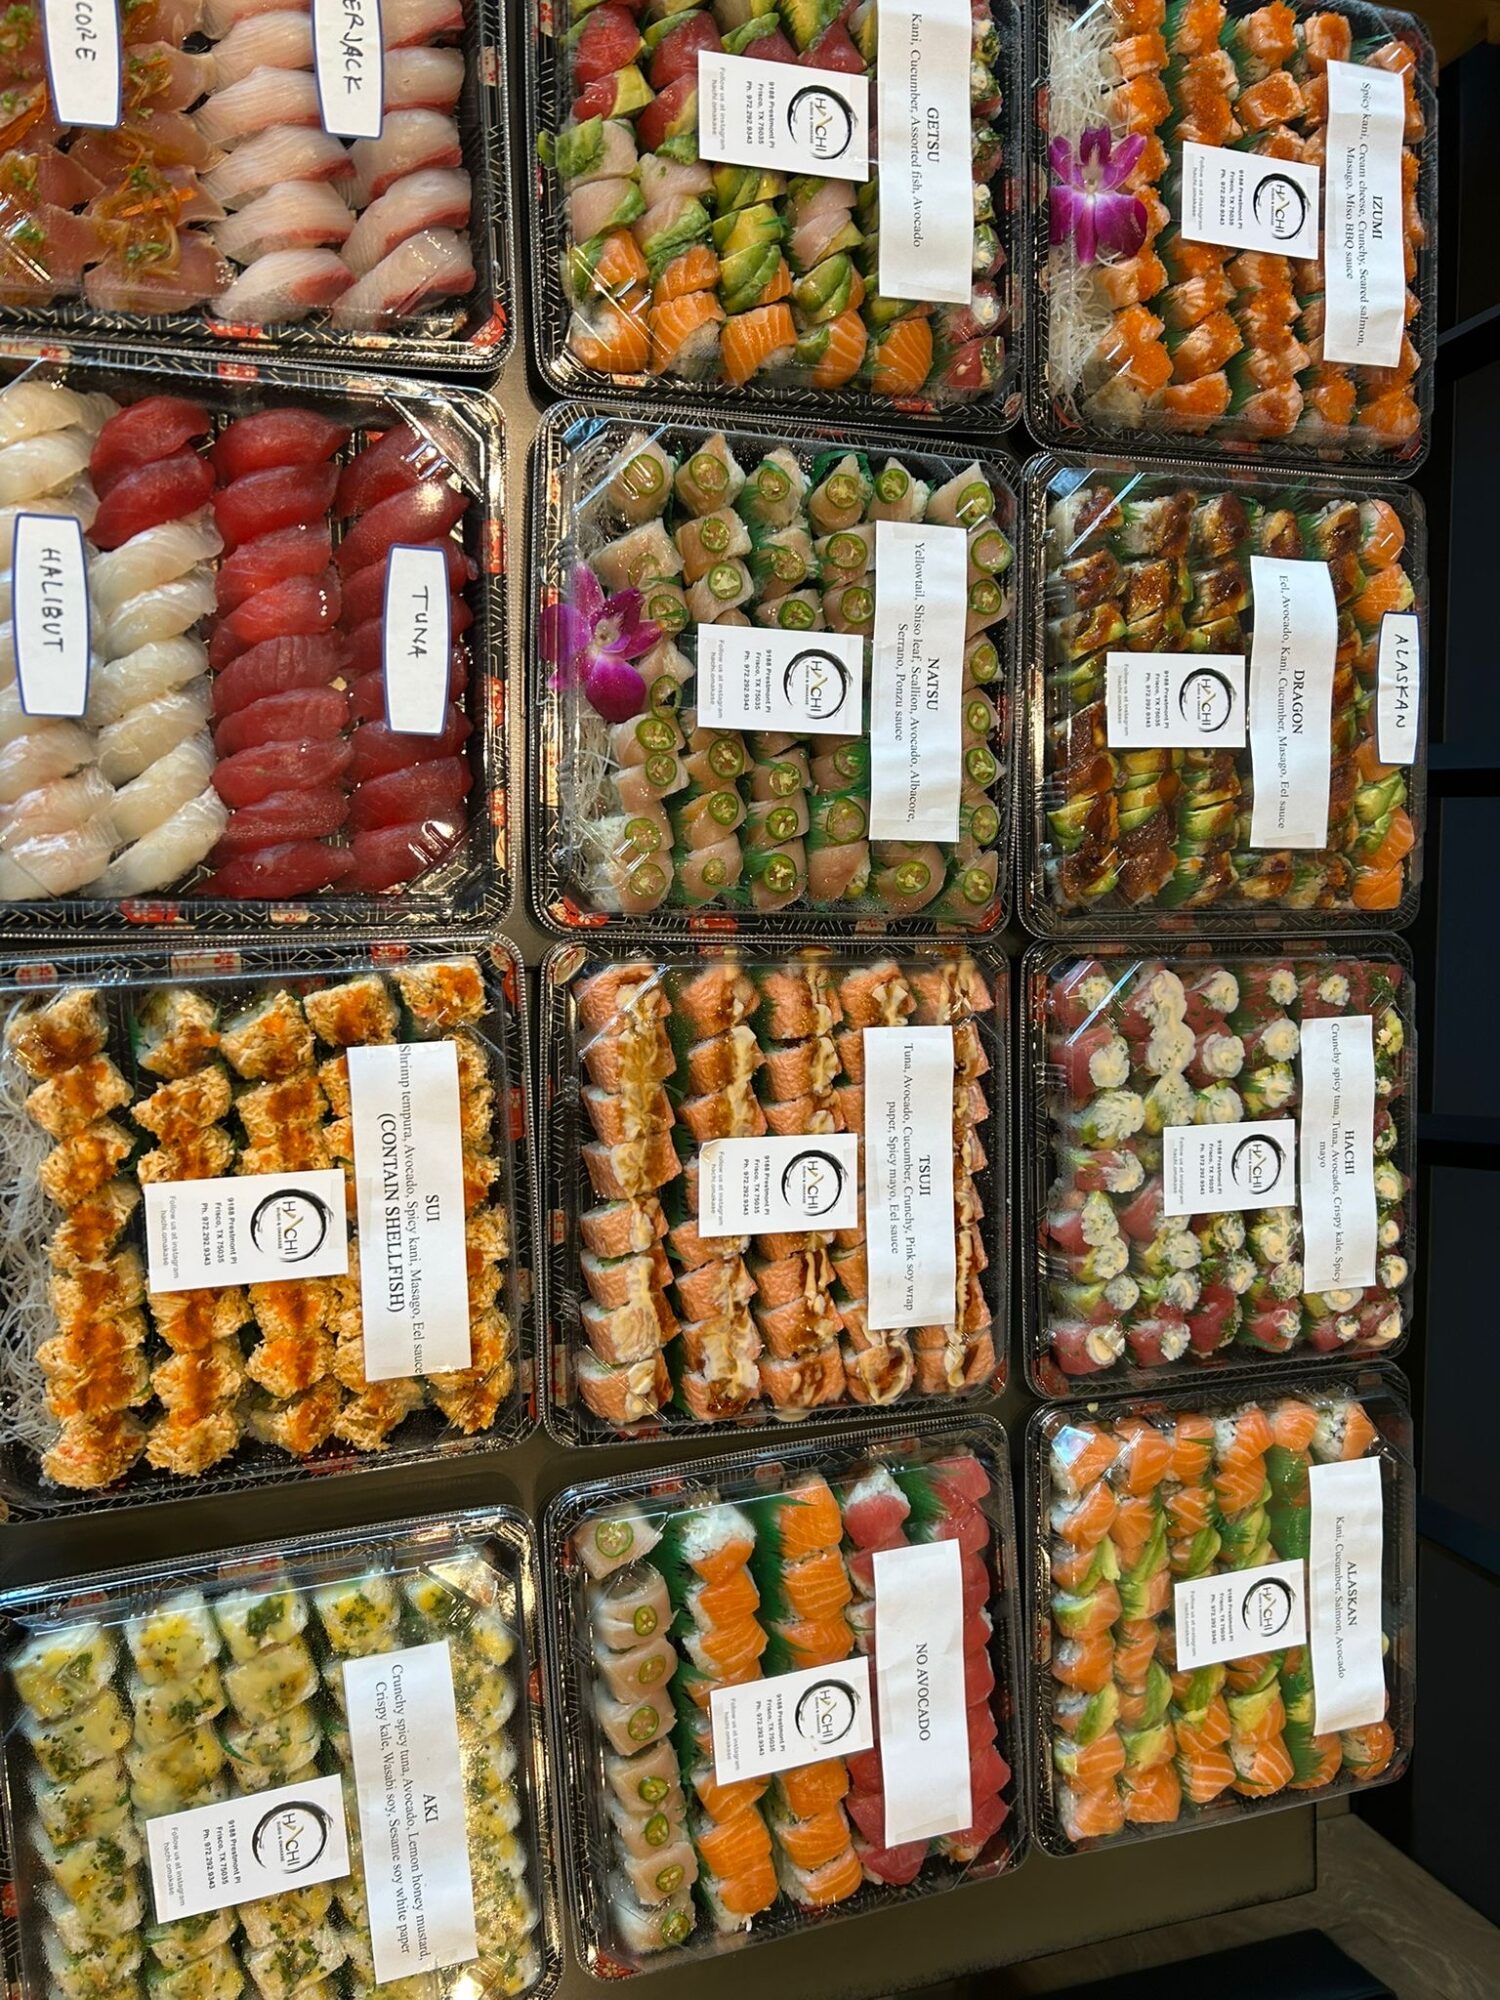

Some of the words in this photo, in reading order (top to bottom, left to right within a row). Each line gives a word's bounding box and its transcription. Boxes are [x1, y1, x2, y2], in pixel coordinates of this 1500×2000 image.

[910, 13, 922, 46] Kani,
[909, 50, 921, 113] Cucumber,
[1360, 82, 1371, 111] Spicy
[758, 110, 764, 120] TX
[815, 98, 832, 152] HACHI
[1360, 114, 1370, 140] kani,
[910, 116, 922, 167] Assorted
[927, 108, 939, 162] GETSU
[1344, 146, 1355, 190] Masago,
[1358, 144, 1368, 177] Cream
[912, 171, 922, 194] fish,
[1358, 180, 1368, 218] cheese,
[913, 196, 923, 248] Avocado
[1275, 184, 1290, 232] HACHI
[1346, 193, 1356, 220] Miso
[1372, 195, 1383, 240] IZUMI
[1344, 223, 1355, 248] BBQ
[1357, 221, 1368, 266] Crunchy,
[1346, 252, 1354, 279] sauce
[1359, 268, 1368, 302] Seared
[1356, 305, 1368, 346] salmon,
[914, 543, 925, 600] Yellowtail,
[1278, 575, 1289, 593] Eel,
[41, 548, 65, 653] HALIBUT
[913, 604, 924, 635] Shiso
[1281, 595, 1291, 643] Avocado,
[408, 586, 429, 659] TUNA
[754, 652, 762, 676] Frisco,
[895, 623, 908, 670] Serrano,
[911, 639, 923, 663] leaf,
[1278, 646, 1289, 675] Kani,
[755, 678, 762, 687] TX
[811, 661, 828, 711] HACHI
[895, 674, 906, 708] Ponzu
[910, 666, 922, 714] Scallion,
[927, 658, 940, 711] NATSU
[1395, 634, 1409, 728] ALASKAN
[1201, 679, 1216, 726] HACHI
[1277, 678, 1288, 733] Cucumber,
[1292, 670, 1305, 735] DRAGON
[895, 711, 904, 741] sauce
[909, 717, 921, 767] Avocado,
[1277, 736, 1288, 777] Masago,
[907, 771, 919, 822] Albacore,
[1280, 781, 1289, 797] Eel
[1278, 801, 1286, 828] sauce
[902, 1044, 914, 1072] Tuna,
[1331, 1023, 1340, 1064] Crunchy
[398, 1045, 413, 1088] Shrimp
[1332, 1067, 1342, 1093] spicy
[401, 1091, 415, 1142] tempura,
[886, 1102, 897, 1134] paper,
[902, 1075, 913, 1123] Avocado,
[1332, 1095, 1342, 1119] tuna,
[887, 1136, 898, 1166] Spicy
[1331, 1121, 1340, 1148] Tuna,
[1344, 1130, 1355, 1175] HACHI
[377, 1113, 400, 1201] (CONTAIN
[404, 1144, 418, 1198] Avocado,
[902, 1126, 914, 1184] Cucumber,
[1253, 1144, 1267, 1188] HACHI
[1318, 1141, 1327, 1167] mayo
[1332, 1150, 1341, 1194] Avocado,
[807, 1161, 824, 1208] HACHI
[888, 1169, 898, 1200] mayo,
[919, 1154, 930, 1196] TSUJI
[215, 1203, 223, 1227] Frisco,
[406, 1201, 420, 1233] Spicy
[425, 1194, 440, 1222] SUI
[890, 1204, 900, 1222] Eel
[902, 1186, 914, 1234] Crunchy,
[1333, 1197, 1343, 1229] Crispy
[203, 1217, 211, 1266] 972.292.9343
[216, 1230, 224, 1239] TX
[282, 1201, 304, 1255] HACHI
[890, 1224, 900, 1254] sauce
[1334, 1232, 1344, 1254] kale,
[385, 1206, 405, 1313] SHELLFISH)
[408, 1236, 421, 1266] kani,
[906, 1236, 916, 1261] Pink
[904, 1264, 914, 1282] soy
[1333, 1257, 1343, 1283] Spicy
[409, 1269, 423, 1320] Masago,
[905, 1286, 914, 1310] wrap
[413, 1322, 425, 1340] Eel
[414, 1344, 424, 1374] sauce
[1335, 1517, 1344, 1541] Kani,
[1334, 1544, 1344, 1593] Cucumber,
[1263, 1587, 1276, 1630] HACHI
[1347, 1562, 1358, 1626] ALASKAN
[1335, 1596, 1344, 1634] Salmon,
[916, 1644, 928, 1665] NO
[1337, 1637, 1346, 1678] Avocado
[374, 1682, 390, 1721] Crispy
[391, 1665, 405, 1715] Crunchy
[916, 1668, 930, 1741] AVOCADO
[395, 1719, 408, 1747] spicy
[820, 1690, 837, 1738] HACHI
[379, 1724, 394, 1750] kale,
[382, 1753, 397, 1791] Wasabi
[400, 1750, 412, 1776] tuna,
[384, 1794, 397, 1817] soy,
[402, 1778, 416, 1830] Avocado,
[423, 1794, 438, 1823] AKI
[215, 1826, 225, 1851] Frisco,
[228, 1820, 236, 1837] 9188
[282, 1813, 304, 1866] HACHI
[388, 1819, 401, 1861] Sesame
[204, 1842, 215, 1889] 972.292.9343
[219, 1853, 227, 1862] TX
[407, 1833, 421, 1872] Lemon
[391, 1864, 403, 1884] soy
[411, 1875, 425, 1911] honey
[395, 1887, 408, 1921] white
[397, 1925, 412, 1953] paper
[415, 1915, 430, 1960] mustard,
